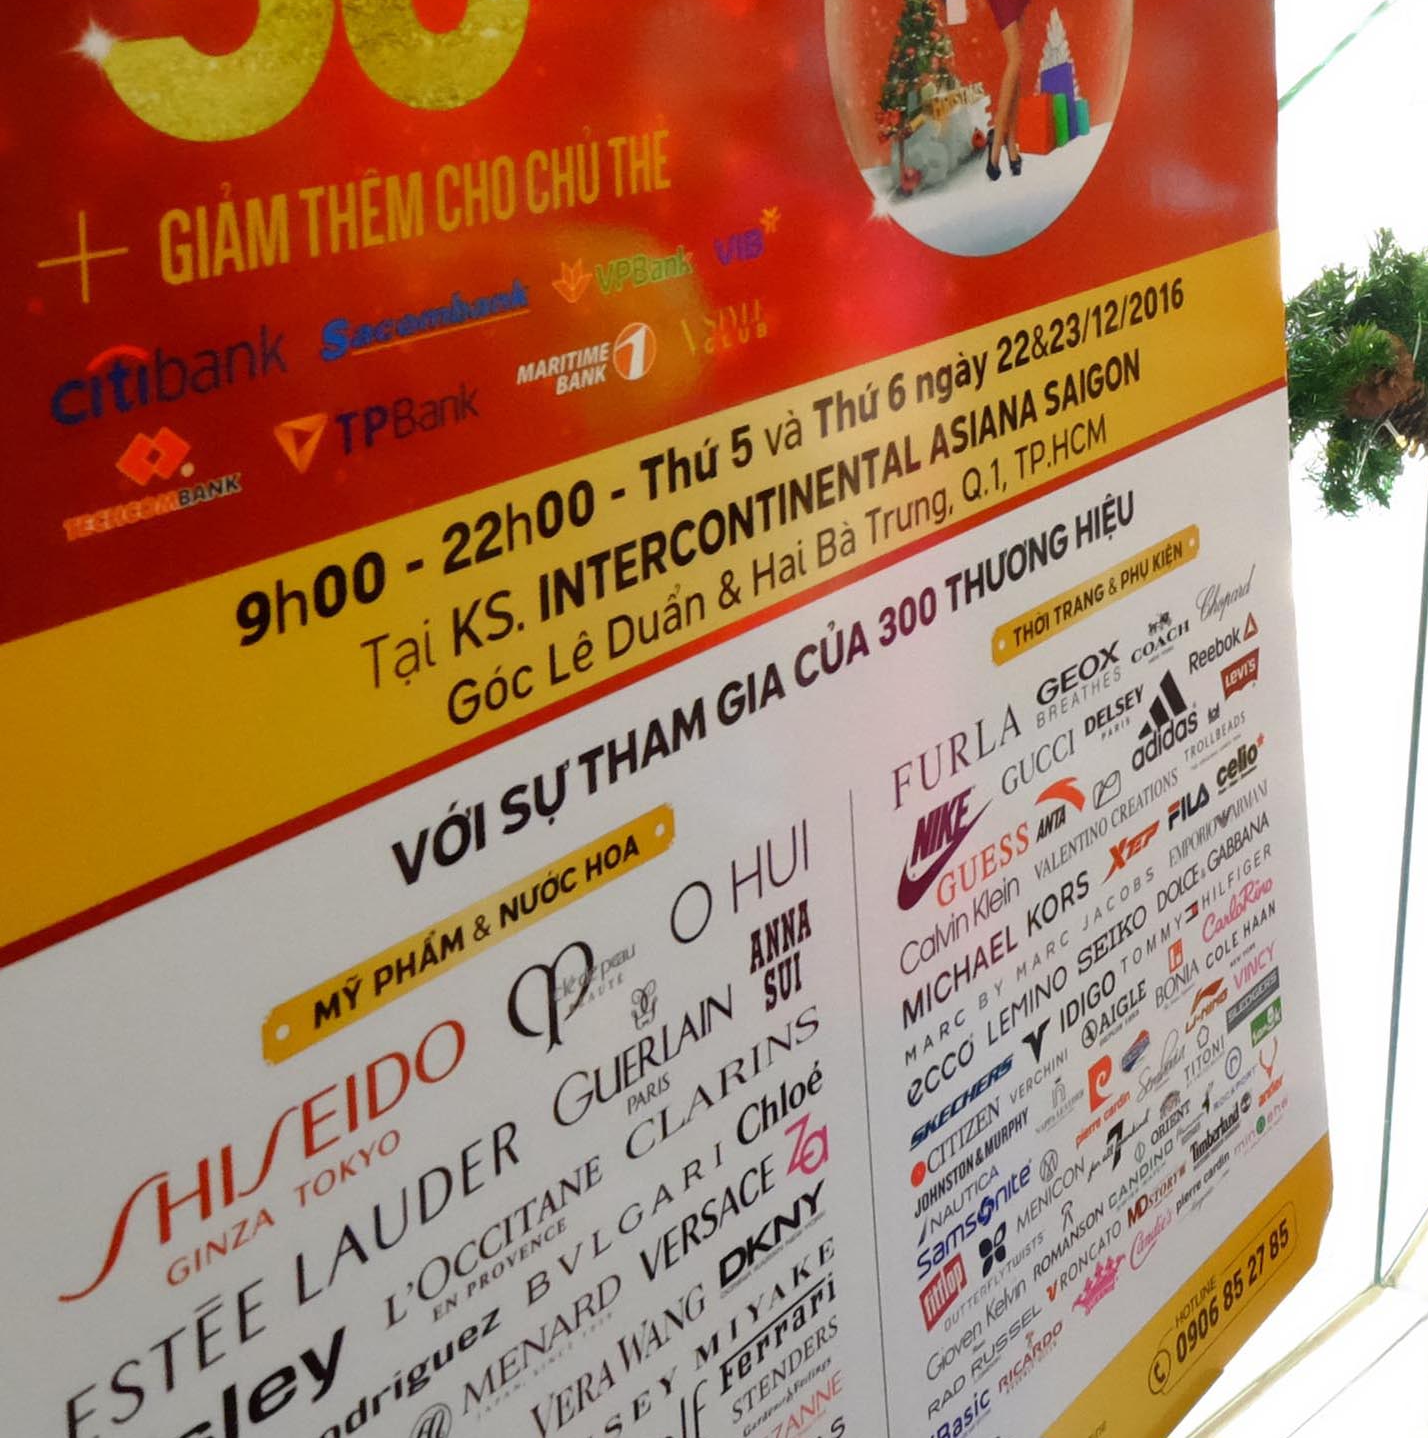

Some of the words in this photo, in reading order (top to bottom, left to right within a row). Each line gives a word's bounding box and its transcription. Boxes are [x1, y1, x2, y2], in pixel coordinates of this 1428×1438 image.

[158, 182, 290, 286] GIẢM
[300, 168, 425, 259] THÊM
[434, 153, 517, 233] CHO
[714, 228, 764, 265] VIB
[594, 244, 695, 296] VPBank
[320, 278, 530, 362] Sacombank
[50, 324, 289, 427] citibank
[516, 341, 611, 386] MARITIME
[555, 363, 608, 397] BANK
[236, 552, 386, 647] 9h00
[441, 479, 596, 576] 22h00
[639, 438, 719, 502] Thứ
[731, 424, 754, 468] 5
[764, 409, 803, 457] và
[812, 375, 879, 441] Thứ
[888, 372, 906, 414] 6
[914, 349, 988, 406] ngày
[995, 276, 1185, 374] 22&23/12/2016
[335, 384, 480, 456] TPBank
[360, 618, 437, 690] Tại
[452, 590, 525, 658] KS.
[538, 440, 922, 623] INTERCONTINENTAL
[928, 388, 1039, 467] ASIANA
[1043, 348, 1142, 417] SAIGON
[447, 662, 534, 726] Góc
[548, 632, 595, 686] Lê
[717, 581, 742, 611] &
[752, 548, 807, 598] Hai
[816, 519, 856, 567] Bà
[864, 487, 954, 548] Trung,
[962, 458, 1008, 504] Q.1,
[1014, 413, 1108, 483] TP.HCM
[1052, 582, 1104, 623] TRANG
[1107, 574, 1118, 596] &
[1035, 640, 1120, 706] GEOX
[1130, 619, 1190, 666] COACH
[1188, 626, 1242, 675] Reebok
[391, 800, 486, 886] VỚI
[499, 759, 571, 835] SỰ
[578, 697, 707, 796] THAM
[716, 663, 786, 727] GIA
[794, 620, 870, 689] CỦA
[878, 586, 937, 647] 300
[1075, 489, 1135, 551] HIỆU
[1035, 666, 1122, 730] BREATHES
[1083, 684, 1145, 738] DELSEY
[890, 702, 1022, 812] FURLA
[1001, 728, 1076, 796] GUCCI
[1131, 710, 1199, 772] adidas
[1183, 710, 1246, 763] TROLLBEADS
[910, 785, 973, 867] NIKE
[1033, 815, 1108, 882] VALENTINO
[1110, 767, 1180, 829] CREATIONS
[1035, 803, 1068, 845] ANTA
[1167, 782, 1210, 832] FILA
[472, 914, 492, 942] &
[585, 834, 641, 883] HOA
[731, 818, 809, 914] HUI
[934, 820, 1031, 909] GUESS
[1156, 861, 1199, 914] DOLCE
[1206, 811, 1271, 873] GABBANA
[749, 898, 812, 975] ANNA
[899, 900, 970, 976] Calvin
[973, 875, 1021, 928] Klein
[1077, 904, 1148, 977] SEIKO
[1120, 913, 1184, 974] TOMMY
[1201, 842, 1272, 911] HILFIGER
[1205, 931, 1239, 970] COLE
[1243, 899, 1276, 939] HAAN
[764, 951, 803, 1013] SUI
[901, 924, 1019, 1031] MICHAEL
[1026, 869, 1090, 939] KORS
[904, 1008, 967, 1063] MARC
[978, 979, 1004, 1012] BY
[1015, 930, 1071, 982] MARC
[1081, 865, 1156, 932] JACOBS
[1154, 958, 1200, 1010] BONIA
[987, 964, 1068, 1047] LEMINO
[1059, 969, 1117, 1035] IDIGO
[1099, 978, 1147, 1036] AIGLE
[552, 983, 733, 1127] GUERLAIN
[625, 1004, 820, 1161] CLARINS
[627, 1071, 671, 1115] PARIS
[1009, 1047, 1069, 1105] VERCHINI
[1183, 1034, 1225, 1082] TITONI
[736, 1059, 823, 1146] Chloé
[909, 1052, 1015, 1152] SKECHERS
[926, 1095, 1001, 1175] CITIZEN
[1150, 1098, 1192, 1146] ORIENT
[58, 1019, 466, 1302] SHISEIDO
[929, 1164, 1001, 1235] NAUTICA
[1016, 1156, 1086, 1234] MENICON
[166, 1208, 275, 1287] GINZA
[293, 1129, 402, 1209] TOKYO
[296, 1121, 520, 1306] LAUDER
[639, 1153, 776, 1282] VERSACE
[719, 1178, 826, 1289] DKNY
[916, 1163, 1032, 1282] Samsonite
[1032, 1201, 1105, 1283] ROMANSON
[432, 1293, 458, 1323] EN
[467, 1216, 567, 1300] PROVENCE
[694, 1235, 836, 1372] MIYAKE
[1174, 1274, 1217, 1328] HOTLINE
[1175, 1297, 1220, 1363] 0906
[1222, 1268, 1244, 1312] 85
[1247, 1243, 1265, 1288] 27
[1269, 1217, 1289, 1261] 85
[462, 1273, 622, 1416] MENARD
[530, 1358, 616, 1438] VERA
[616, 1282, 707, 1373] WANG
[719, 1271, 837, 1397] Ferrari
[731, 1314, 840, 1425] STENDERS
[926, 1374, 967, 1422] RAD
[970, 1304, 1043, 1379] RUSSEL
[997, 1319, 1064, 1395] RICARDO
